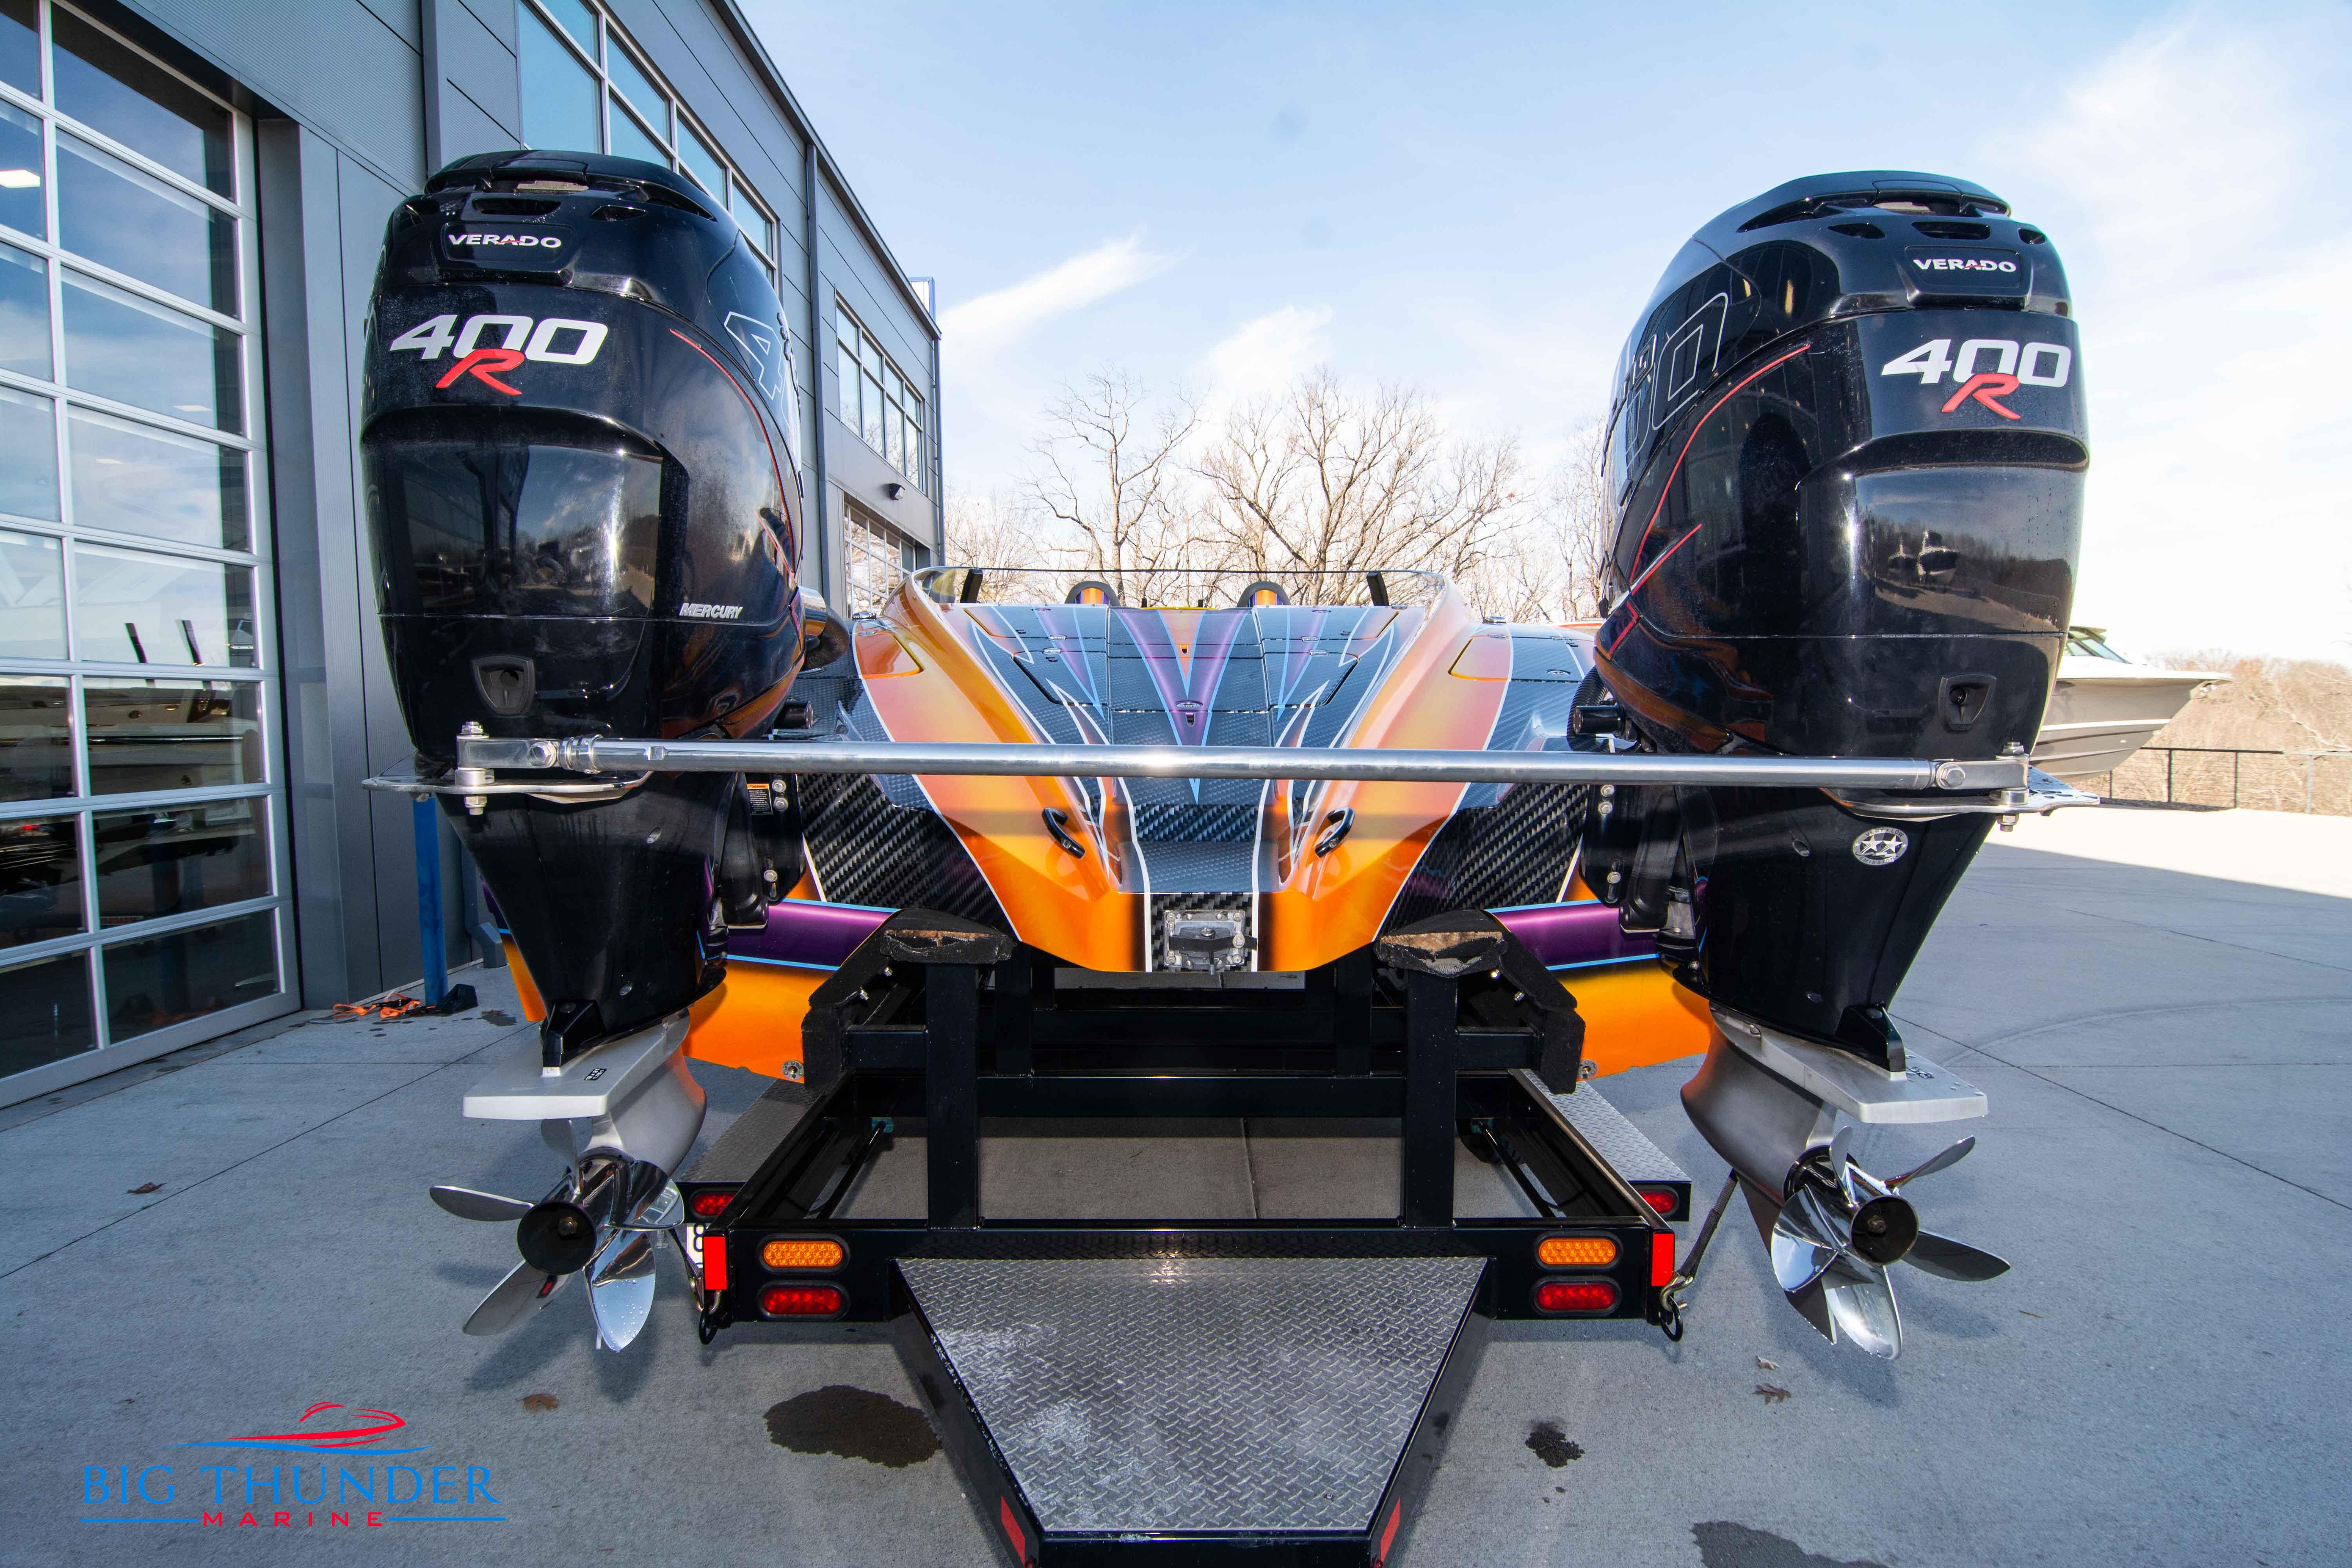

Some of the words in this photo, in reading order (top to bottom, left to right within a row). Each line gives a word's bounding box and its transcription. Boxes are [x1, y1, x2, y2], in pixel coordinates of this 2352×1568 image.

[448, 234, 562, 248] VERADO
[1913, 259, 2016, 273] VERADO
[389, 314, 608, 365] 400
[435, 348, 525, 396] R
[1881, 339, 2072, 388] 400
[1941, 372, 2021, 420] R
[679, 602, 744, 619] MERCURY
[1866, 828, 1884, 836] VERY
[1891, 828, 1904, 837] LOW
